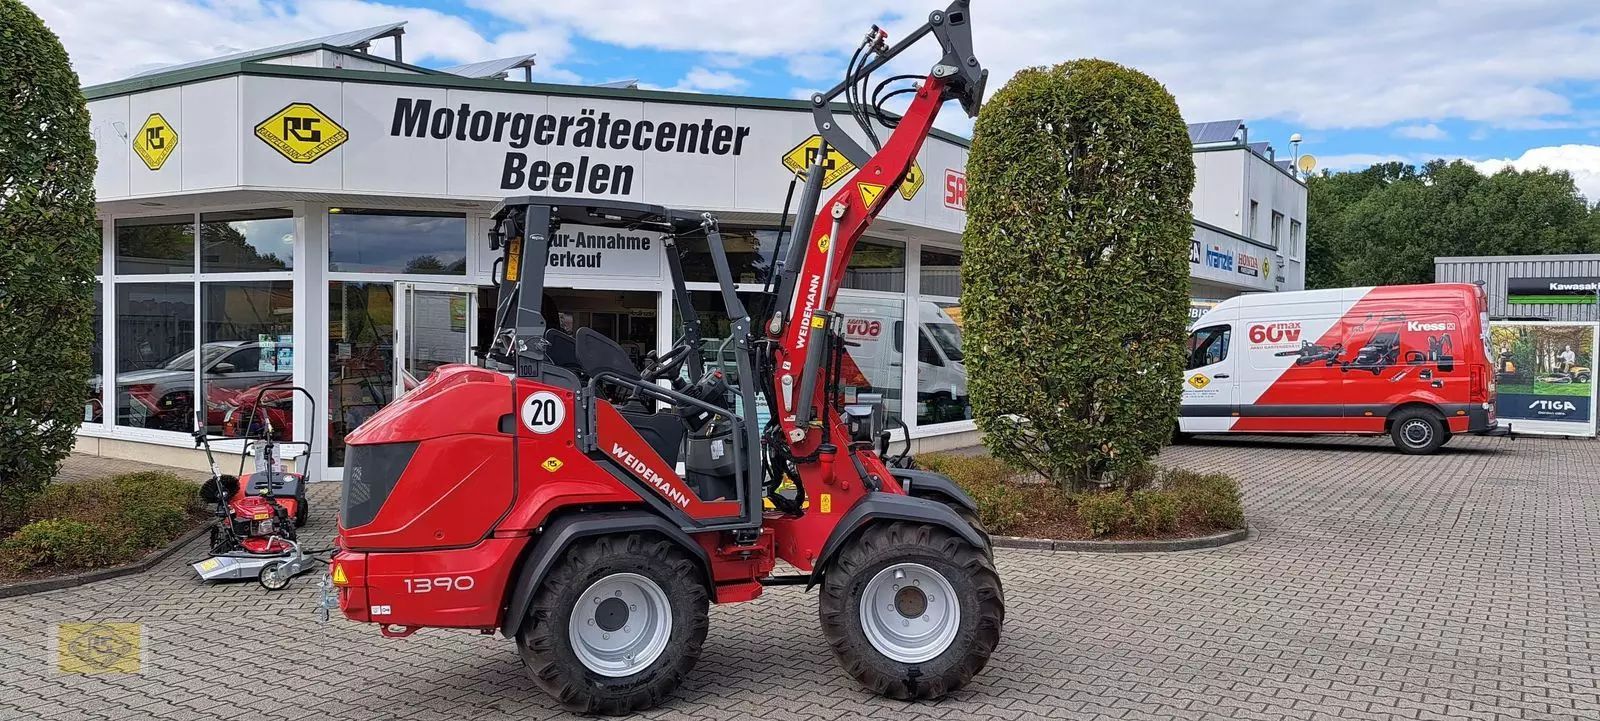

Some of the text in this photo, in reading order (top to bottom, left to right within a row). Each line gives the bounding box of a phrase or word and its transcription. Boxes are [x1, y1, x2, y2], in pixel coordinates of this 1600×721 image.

[283, 116, 321, 142] RS
[391, 97, 750, 156] Motorgerätecenter
[500, 152, 634, 195] Beelen
[544, 250, 602, 268] erkauf
[1238, 253, 1258, 269] HONDA
[795, 275, 820, 349] WEIDEMANN
[1277, 322, 1301, 330] max
[1408, 321, 1446, 331] Kress
[531, 399, 556, 426] 20
[1529, 400, 1577, 411] STIGA
[611, 442, 690, 508] WEIDEMANN
[404, 575, 475, 594] 1390
